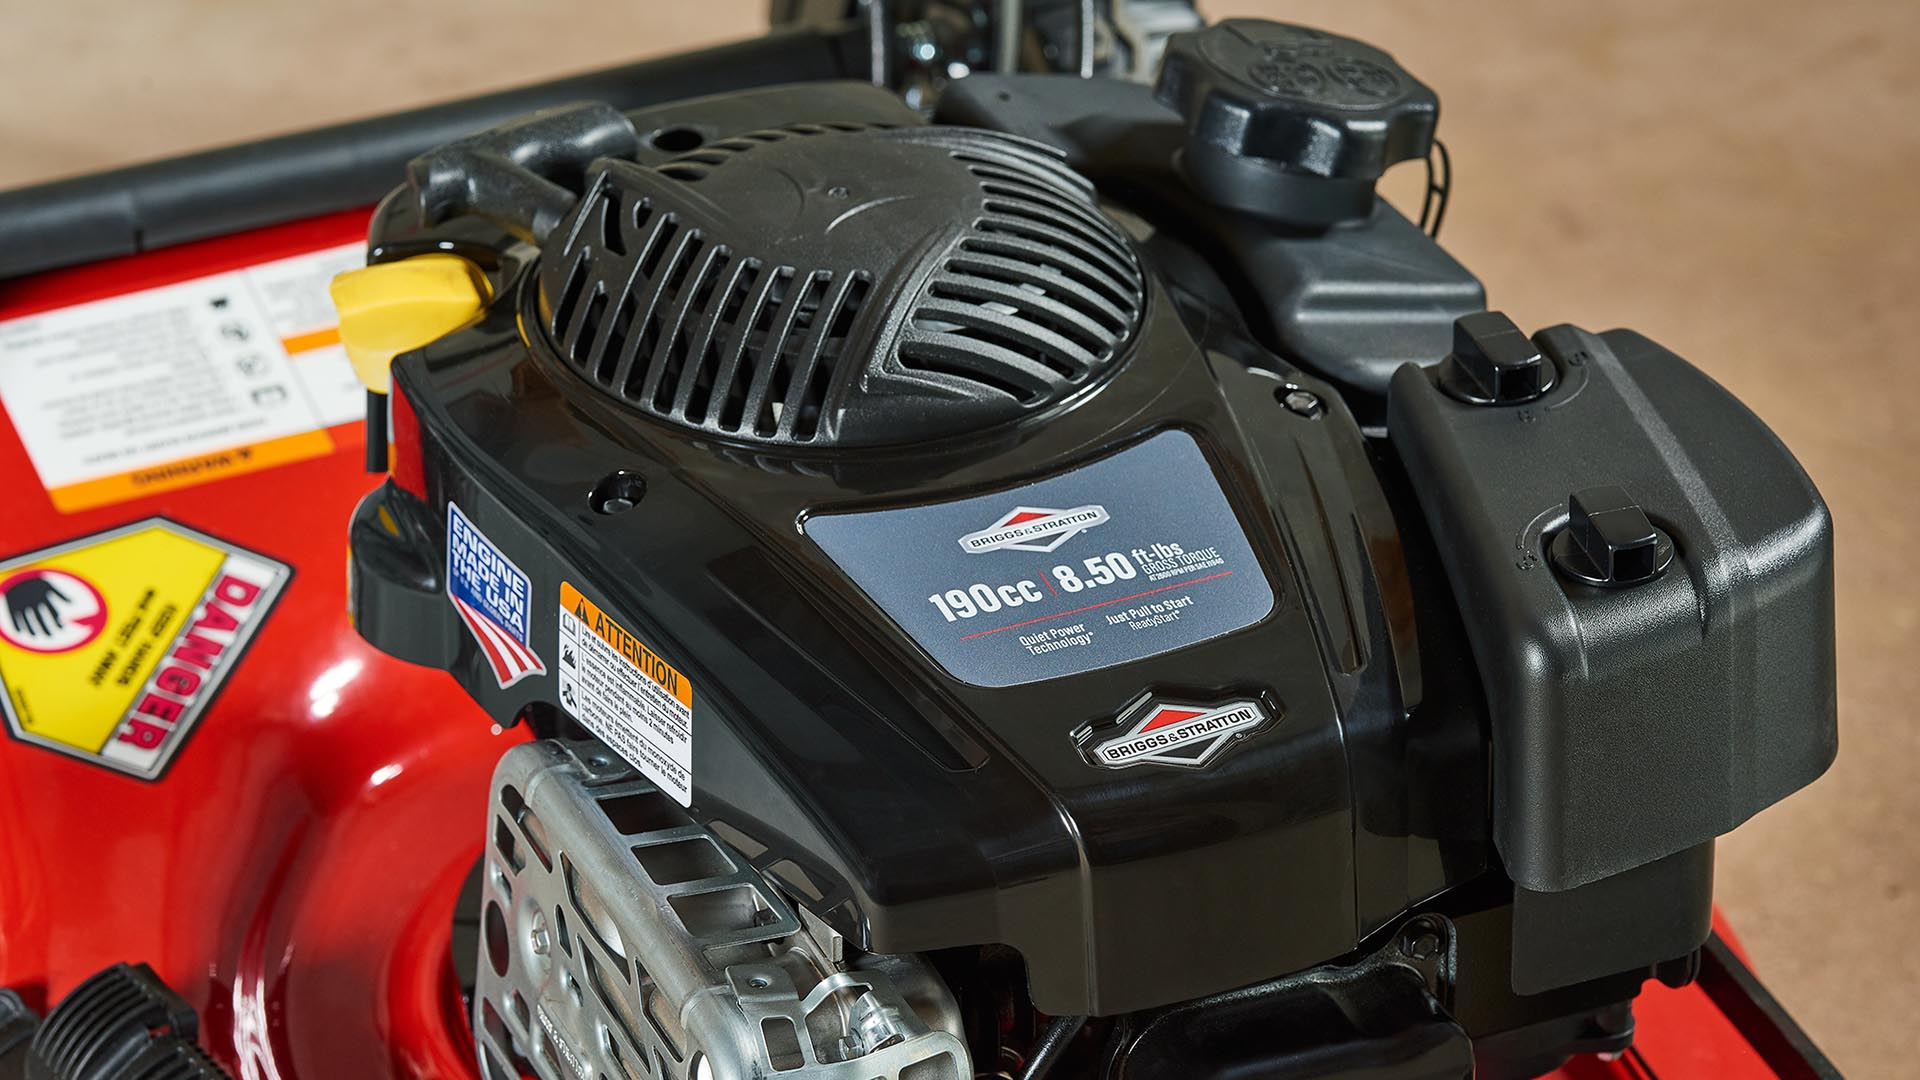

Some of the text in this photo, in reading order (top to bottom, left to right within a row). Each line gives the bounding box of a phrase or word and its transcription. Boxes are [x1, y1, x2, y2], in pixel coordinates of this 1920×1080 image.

[451, 548, 481, 592] THE
[485, 585, 524, 634] USA
[453, 514, 524, 598] ENGINE
[453, 533, 499, 593] MADE
[505, 586, 524, 616] IN
[928, 543, 1184, 622] 190cc 8.50 ft-lbs
[1141, 546, 1220, 575] GROSS TORQUE
[1019, 623, 1086, 647] Quiet Power
[1105, 595, 1194, 625] Just Pull to Start
[118, 574, 261, 750] DANGER
[595, 612, 678, 696] ATTENTION
[649, 717, 651, 727] 2
